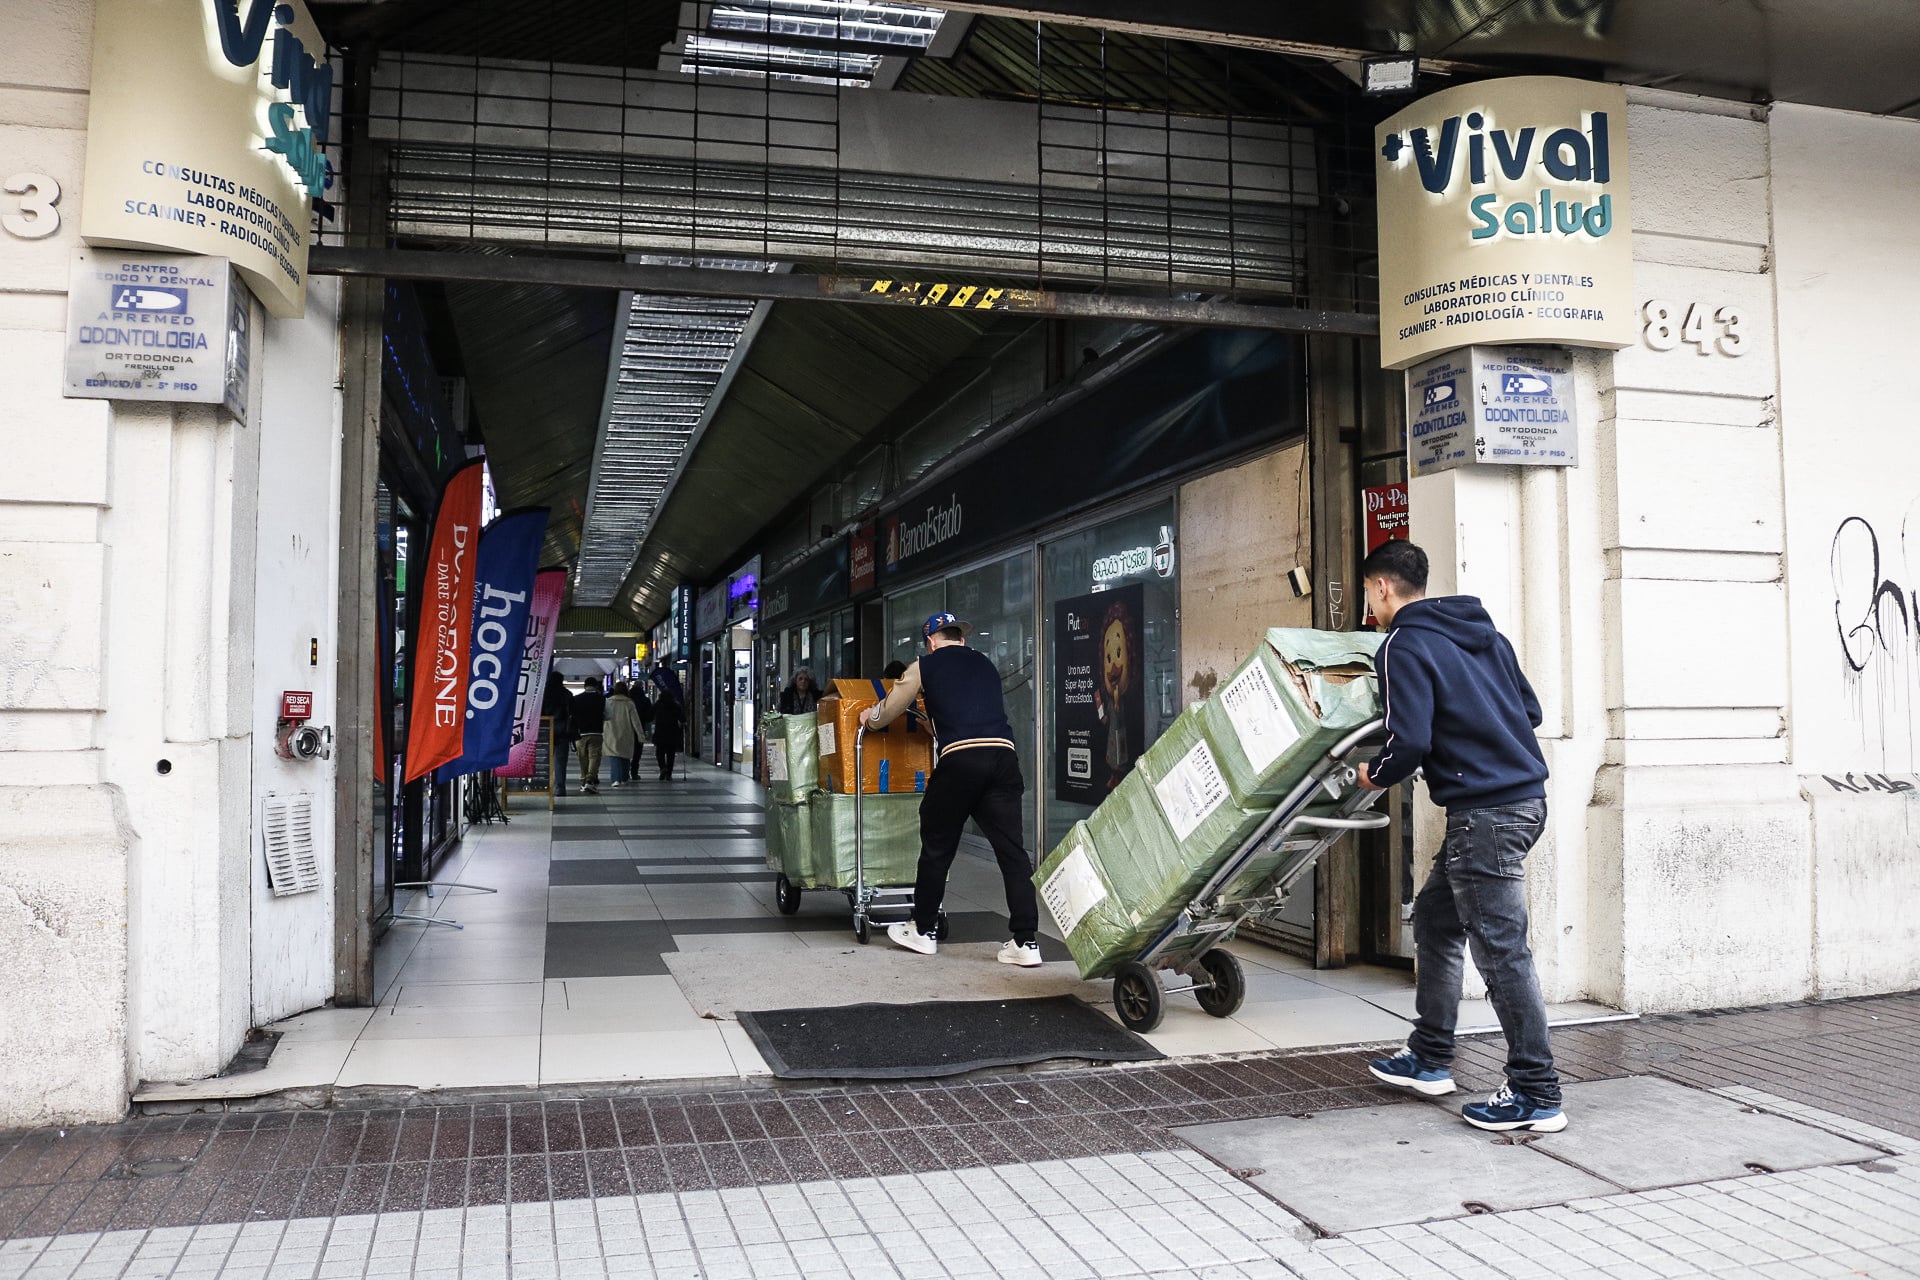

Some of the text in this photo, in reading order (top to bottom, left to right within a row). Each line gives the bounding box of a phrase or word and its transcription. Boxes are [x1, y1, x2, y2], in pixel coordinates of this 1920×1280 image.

[1408, 111, 1610, 194] Vival
[142, 160, 236, 195] CONSULTAS
[2, 172, 62, 240] 3
[124, 200, 206, 228] SCANNER
[186, 190, 272, 234] LABORATORIO
[1470, 189, 1612, 240] Salud
[122, 264, 178, 274] CENTRO
[145, 275, 153, 283] Y
[160, 276, 215, 286] DENTAL
[1404, 274, 1594, 306] CONSULTAS MÉDICAS Y DENTALES
[1424, 288, 1565, 315] LABORATORIO CLÍNICO
[98, 312, 195, 326] APREMED
[1399, 319, 1437, 340] SCANNER
[1446, 306, 1525, 326] RADIOLOGÍA
[1642, 298, 1751, 358] 843
[80, 326, 208, 350] ODONTOLOGIA
[105, 352, 194, 364] ORTODONCIA
[1427, 364, 1451, 376] CENTRO
[1507, 357, 1543, 365] CENTRO
[86, 379, 130, 388] EDIFICIO
[173, 383, 197, 391] PISO
[1442, 368, 1467, 380] DENTAL
[1419, 400, 1459, 417] APREMED
[1495, 396, 1558, 405] APREMED
[1413, 411, 1467, 437] ODONTOLOGIA
[1485, 408, 1569, 423] ODONTOLOGIA
[1421, 432, 1458, 446] ORTODONCIA
[900, 492, 962, 560] BancoEstado
[437, 562, 449, 600] DARE
[437, 604, 448, 623] TO
[465, 583, 526, 720] hoco.
[286, 696, 310, 704] RED SECA
